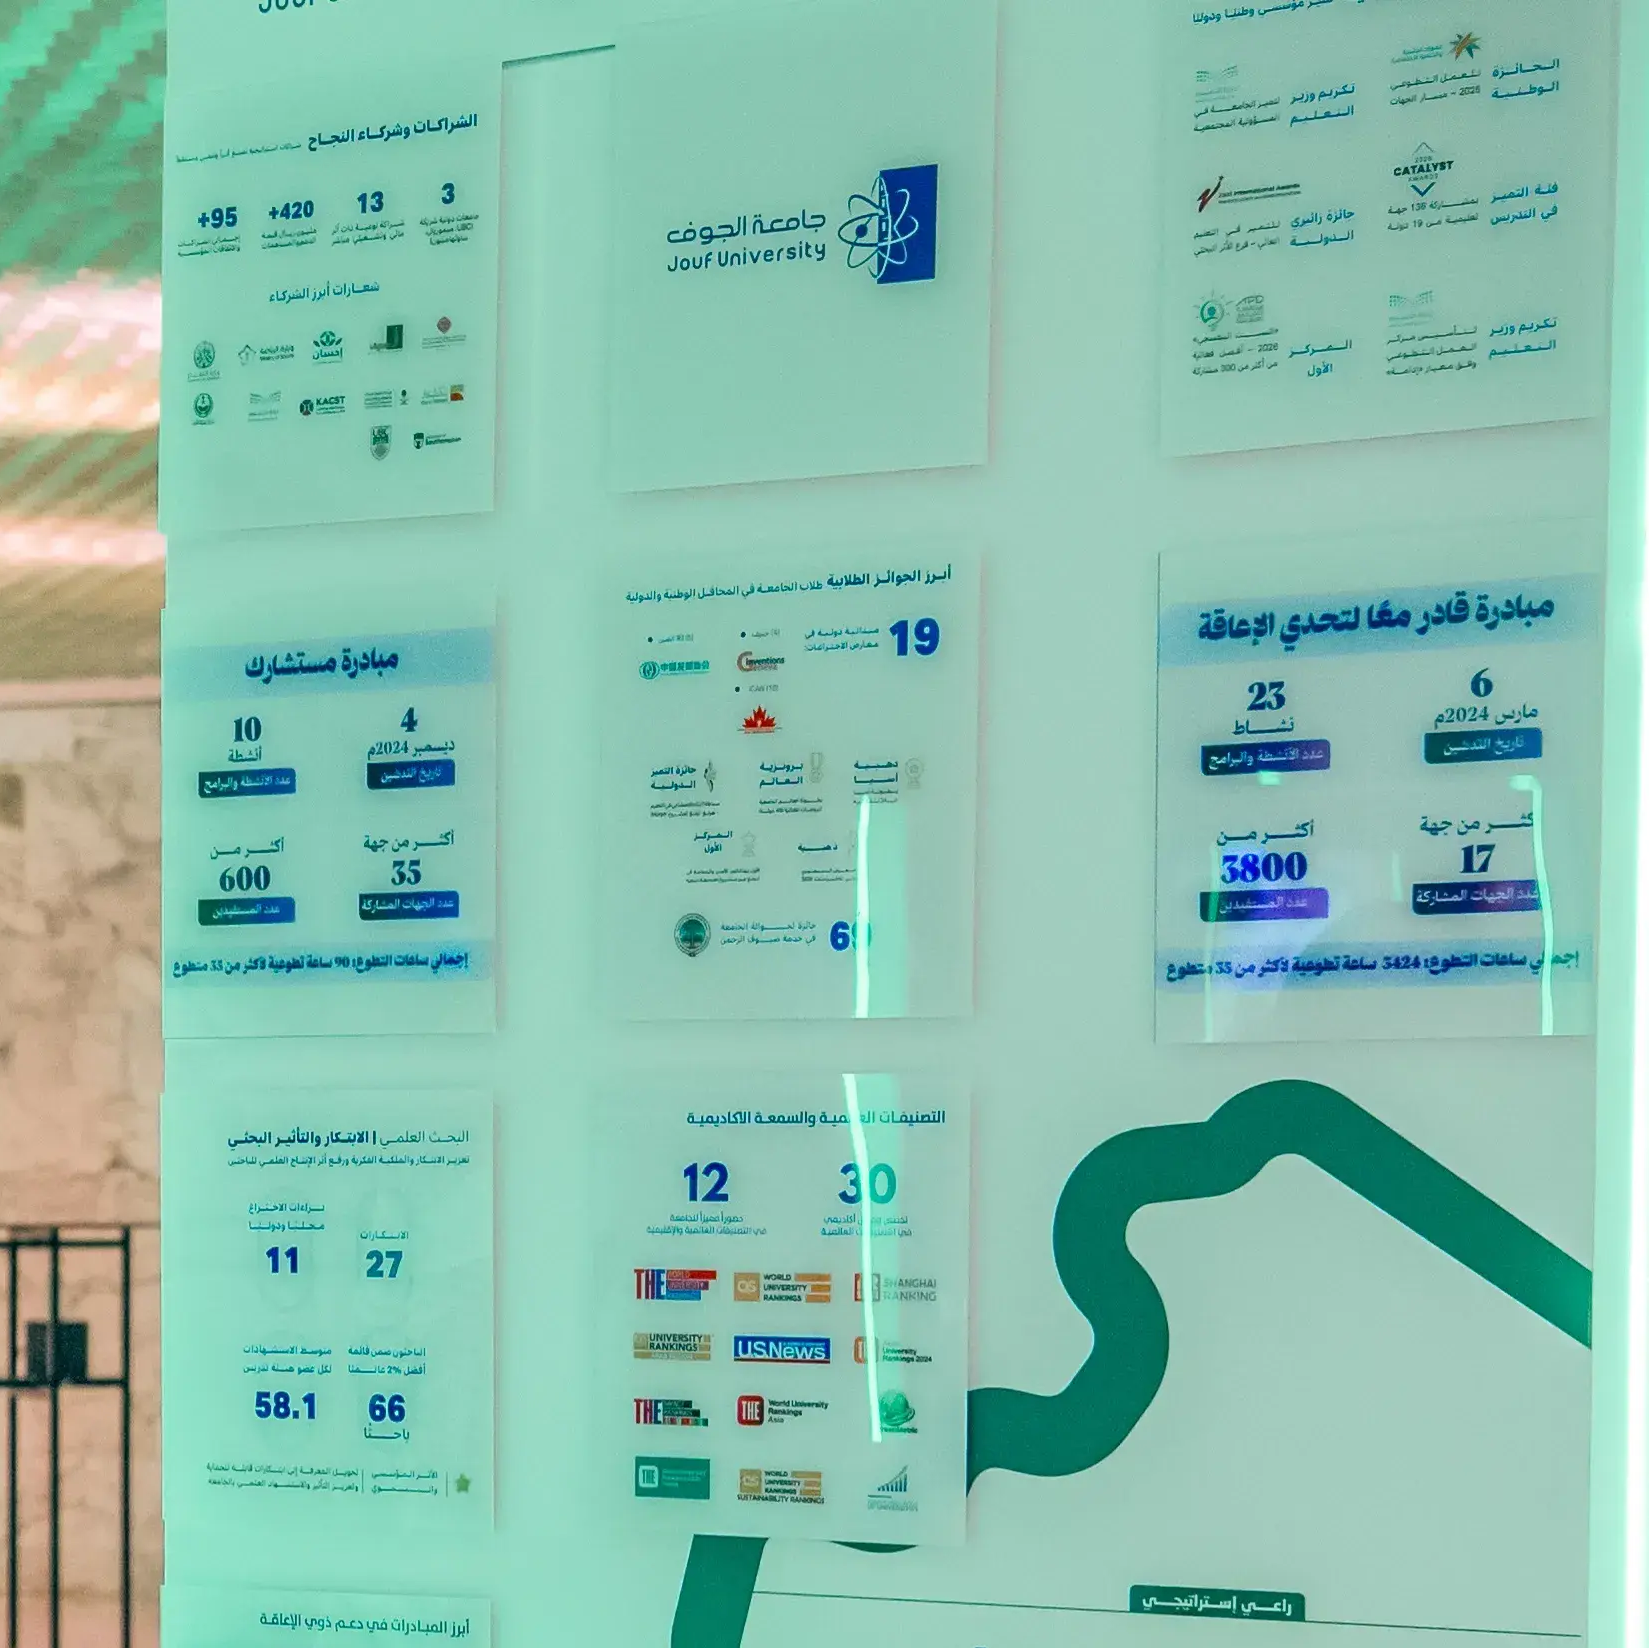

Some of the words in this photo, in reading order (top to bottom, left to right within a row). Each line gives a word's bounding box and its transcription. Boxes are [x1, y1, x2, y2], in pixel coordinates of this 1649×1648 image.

[1492, 59, 1560, 79] الجائزة
[1318, 83, 1355, 102] تكريم
[1491, 81, 1559, 99] الوطنية
[413, 113, 479, 135] الشراكات
[1290, 105, 1354, 127] التعليم
[308, 129, 355, 151] النجاح
[358, 121, 411, 140] وشركاء
[1394, 161, 1454, 176] CATALYST
[357, 191, 384, 213] 13
[441, 182, 455, 204] 3
[198, 207, 238, 229] +95
[268, 200, 314, 220] +420
[666, 216, 747, 245] الجوف
[752, 209, 826, 235] جامعة
[1290, 230, 1354, 247] الدولية
[667, 252, 712, 272] Jouf
[718, 240, 826, 268] University
[269, 287, 310, 304] الشركاء
[1518, 317, 1558, 335] تكريم
[1288, 340, 1352, 358] المركز
[1489, 339, 1556, 360] التعليم
[1307, 361, 1333, 378] الأول
[315, 396, 346, 406] KACST
[827, 573, 870, 590] الطلابية
[874, 568, 921, 590] الجوائز
[924, 563, 952, 585] أبرز
[663, 588, 696, 601] الوطنية
[757, 580, 798, 595] الجامعة
[1415, 590, 1471, 636] قادر
[1474, 592, 1556, 633] مبادرة
[889, 617, 941, 657] 19
[1198, 607, 1275, 647] الإعاقة
[1279, 605, 1361, 652] لتحدي
[244, 649, 337, 684] مستشارك
[341, 647, 399, 680] مبادرة
[1470, 667, 1494, 698] 6
[1246, 680, 1286, 713] 23
[400, 706, 418, 733] 4
[1493, 704, 1539, 726] مارس
[233, 716, 262, 743] 10
[1231, 717, 1295, 737] نشاط
[227, 746, 263, 763] أنشطة
[412, 740, 456, 757] ديسمبر
[1260, 818, 1315, 843] أكثر
[1419, 815, 1453, 835] جهة
[1456, 816, 1481, 835] من
[363, 836, 389, 852] جهة
[391, 837, 409, 851] من
[413, 829, 455, 852] أكثر
[1216, 827, 1256, 846] من
[210, 845, 241, 860] من
[243, 837, 285, 859] أكثر
[1220, 851, 1307, 885] 3800
[1459, 844, 1496, 874] 17
[219, 865, 271, 892] 600
[391, 859, 422, 886] 35
[755, 1111, 816, 1128] والسمعة
[228, 1131, 272, 1149] البحثي
[275, 1127, 321, 1148] والتأثير
[325, 1131, 369, 1148] الابتكار
[380, 1131, 425, 1149] العلمي
[429, 1130, 469, 1143] البحث
[684, 1161, 729, 1203] 12
[265, 1246, 299, 1275] 11
[365, 1249, 404, 1279] 27
[634, 1269, 667, 1300] THE
[763, 1273, 791, 1281] WORLD
[883, 1277, 936, 1289] SHANGHAI
[763, 1284, 807, 1292] UNIVERSITY
[763, 1294, 802, 1302] RANKINGS
[883, 1290, 936, 1301] RANKING
[649, 1334, 703, 1342] UNIVERSITY
[649, 1343, 698, 1351] RANKINGS
[883, 1347, 917, 1356] University
[255, 1391, 316, 1419] 58.1
[369, 1394, 406, 1422] 66
[634, 1398, 663, 1425] THE
[742, 1401, 760, 1420] THE
[768, 1399, 790, 1407] World
[791, 1400, 829, 1410] University
[768, 1408, 803, 1417] Rankings
[737, 1494, 789, 1503] SUSTAINABILITY
[790, 1495, 825, 1504] RANKINGS
[1240, 1593, 1294, 1620] راعي
[259, 1613, 302, 1632] الإعاقة
[305, 1614, 332, 1632] ذوي
[335, 1618, 364, 1633] دعم
[367, 1619, 388, 1634] في
[391, 1616, 448, 1636] المبادرات
[451, 1618, 470, 1638] أبرز
